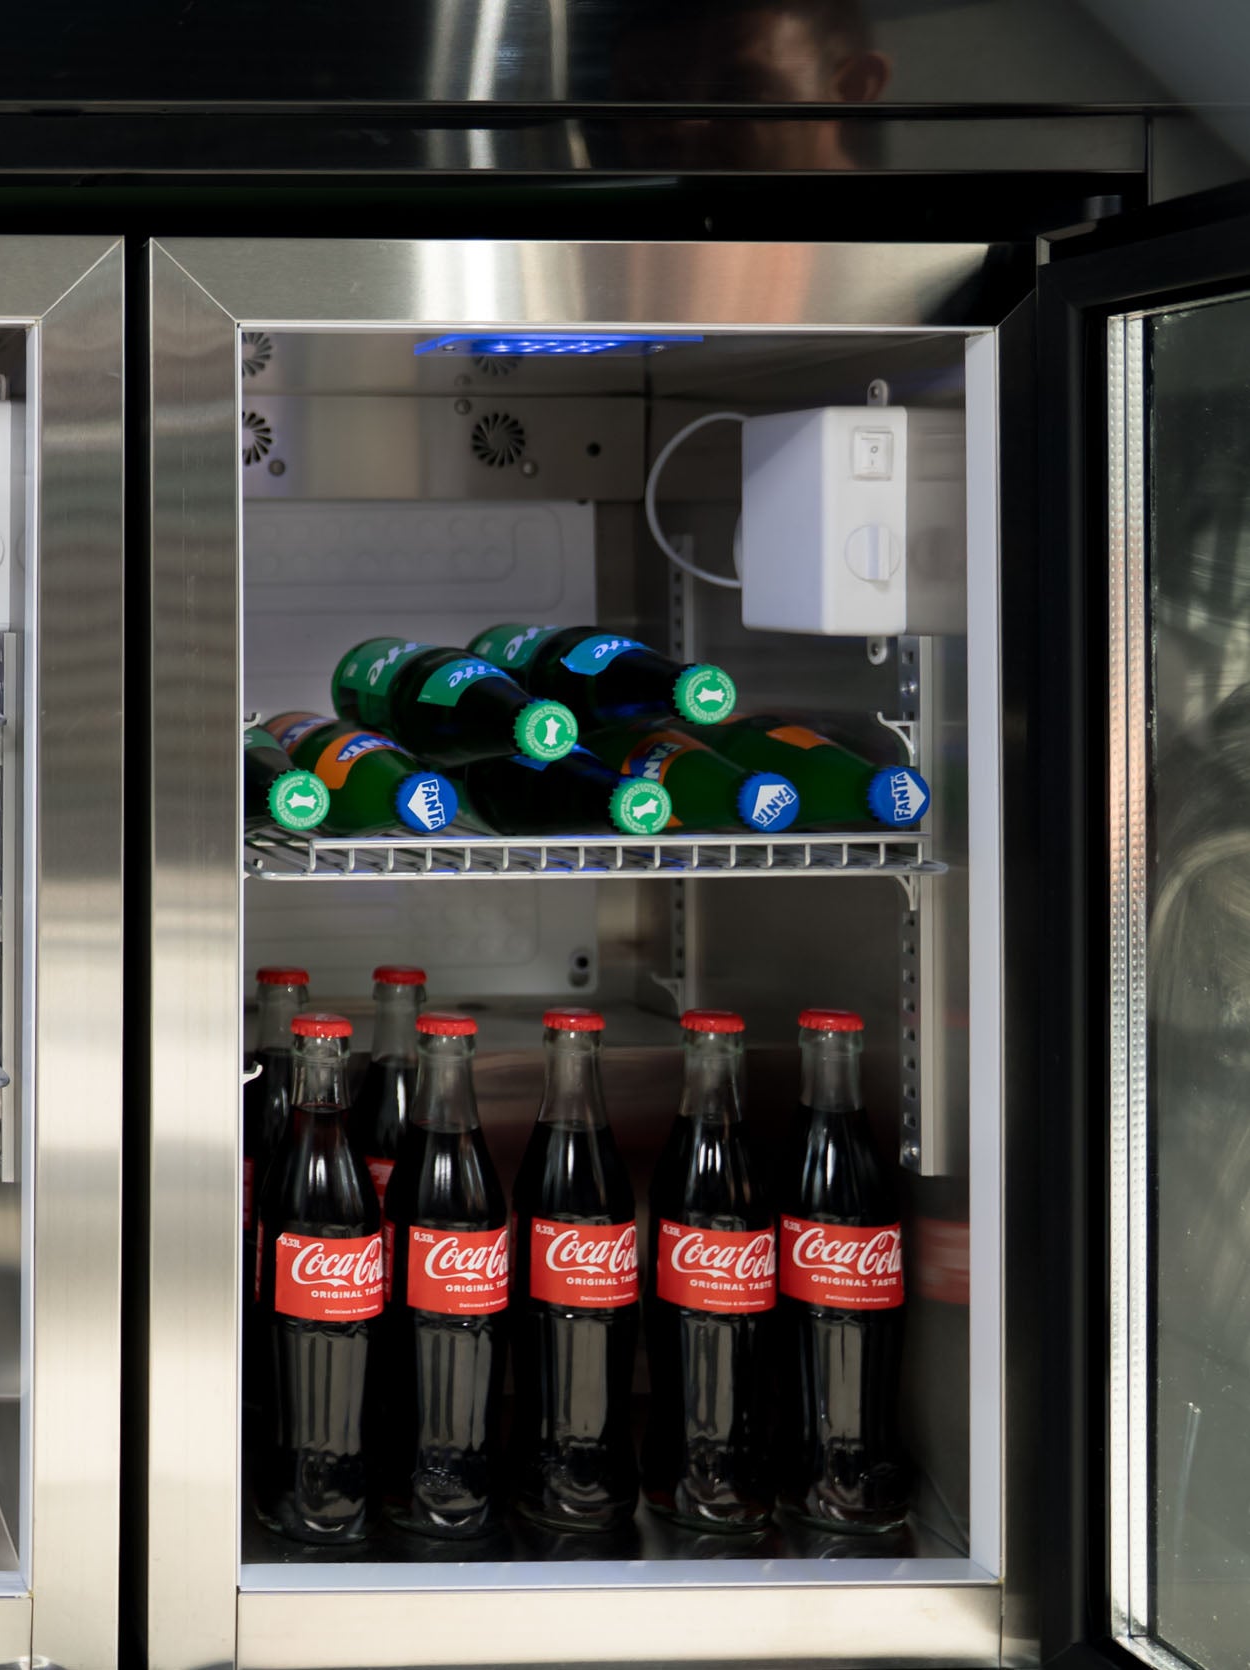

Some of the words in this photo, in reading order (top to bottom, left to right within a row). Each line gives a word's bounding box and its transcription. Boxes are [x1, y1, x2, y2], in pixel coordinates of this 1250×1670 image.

[892, 772, 912, 820] FANTA
[420, 780, 444, 829] FANTA
[753, 786, 796, 825] FANTA
[566, 1276, 618, 1286] ORIGINAL
[690, 1279, 745, 1291] ORIGINAL
[811, 1274, 868, 1288] ORIGINAL
[311, 1290, 363, 1299] ORIGINAL
[445, 1284, 494, 1293] ORIGINAL
